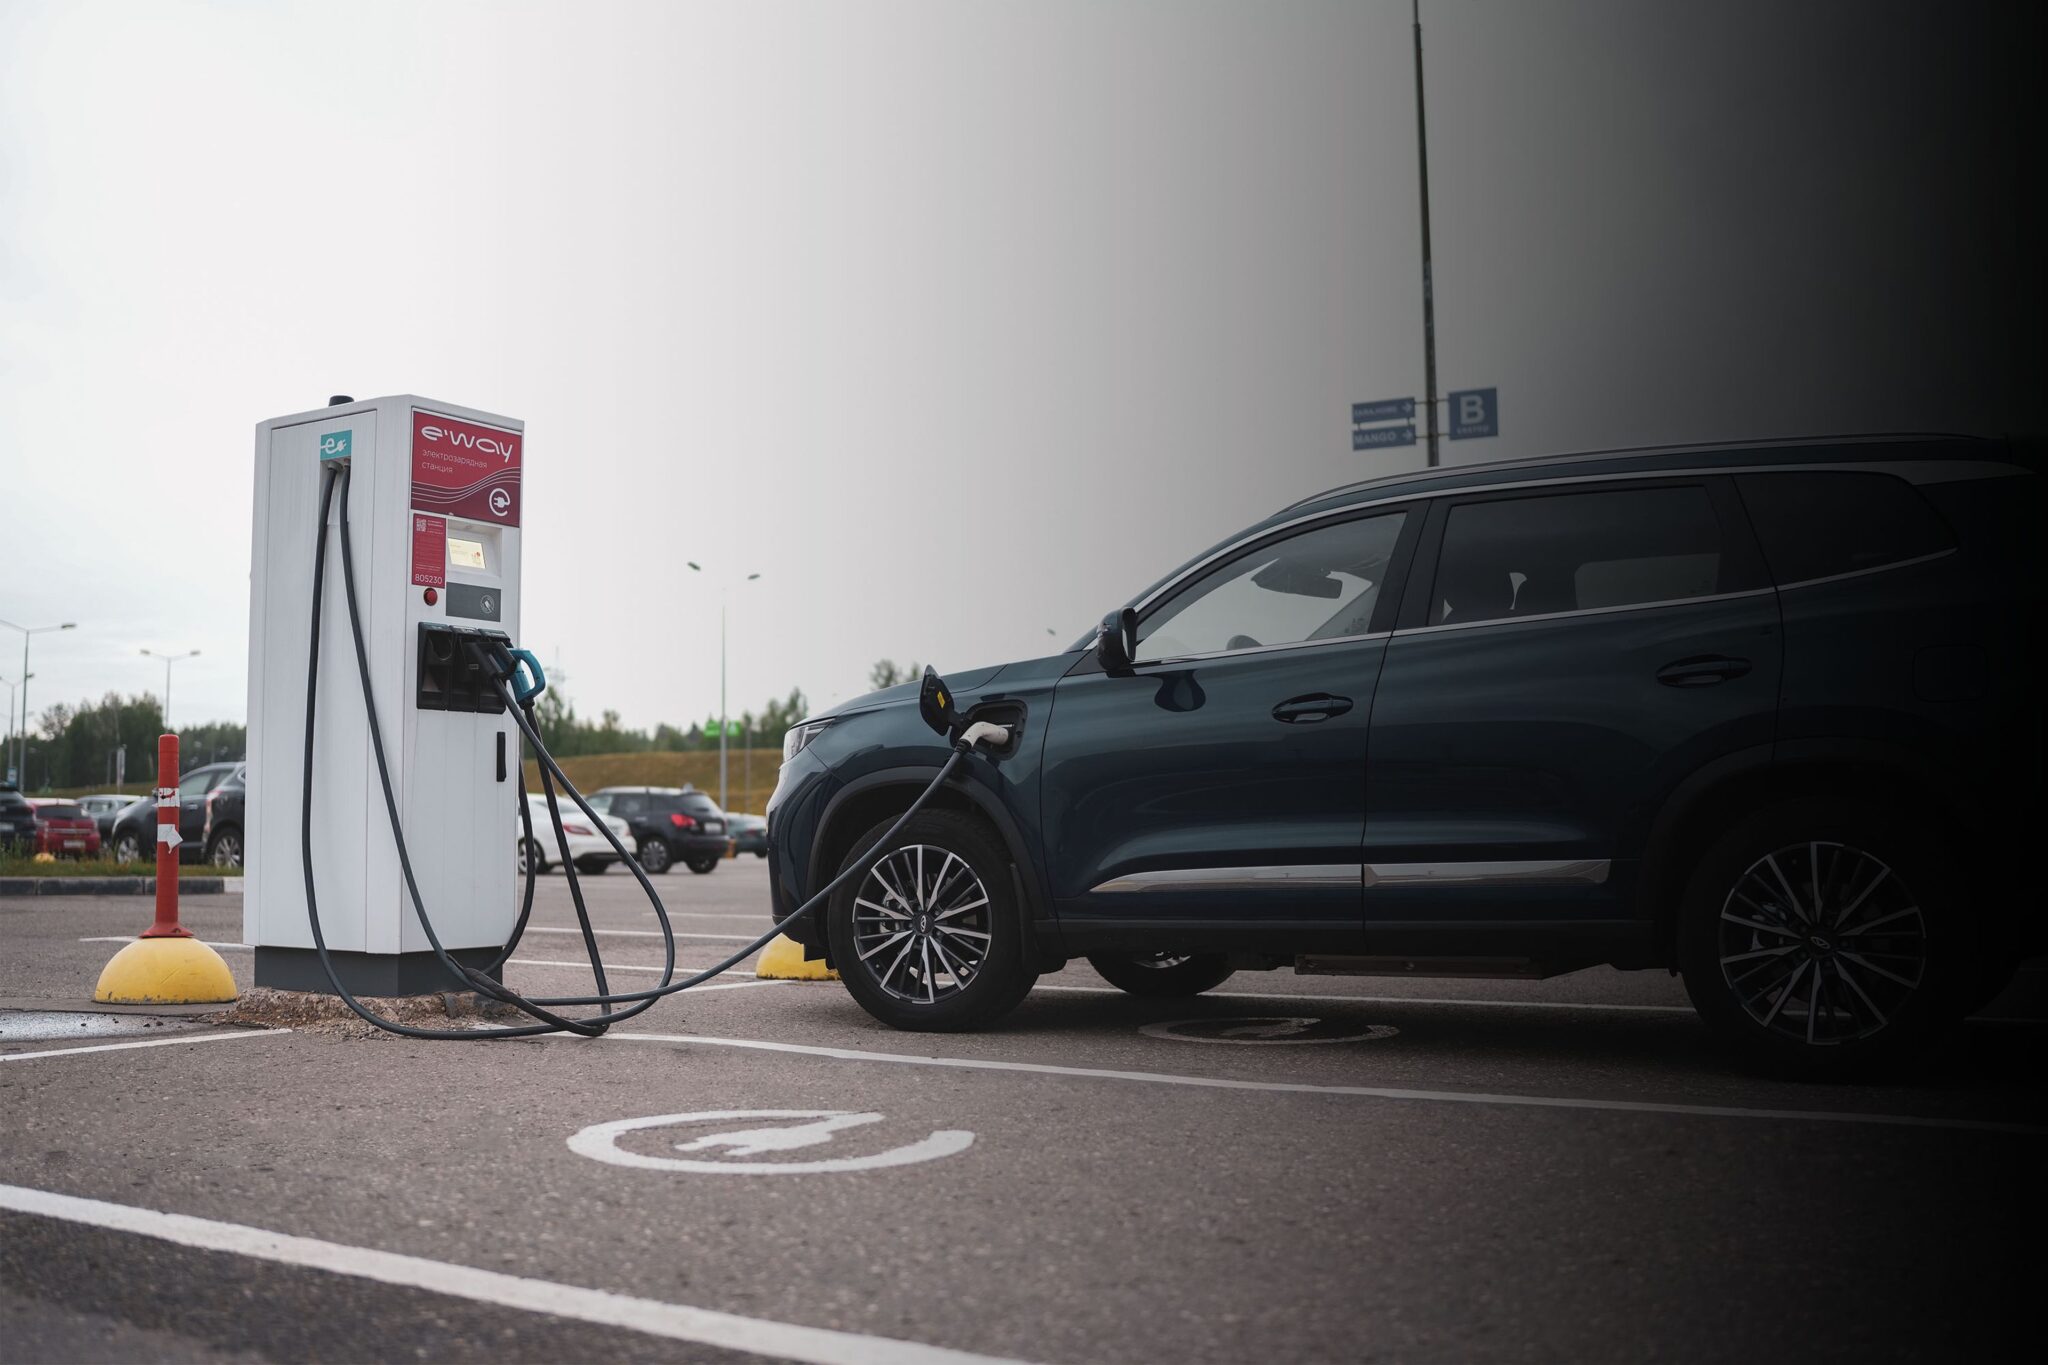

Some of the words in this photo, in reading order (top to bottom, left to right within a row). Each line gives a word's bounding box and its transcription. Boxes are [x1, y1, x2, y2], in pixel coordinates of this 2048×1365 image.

[422, 449, 488, 468] электрозарядная
[422, 461, 453, 473] станция
[415, 573, 443, 585] 805230
